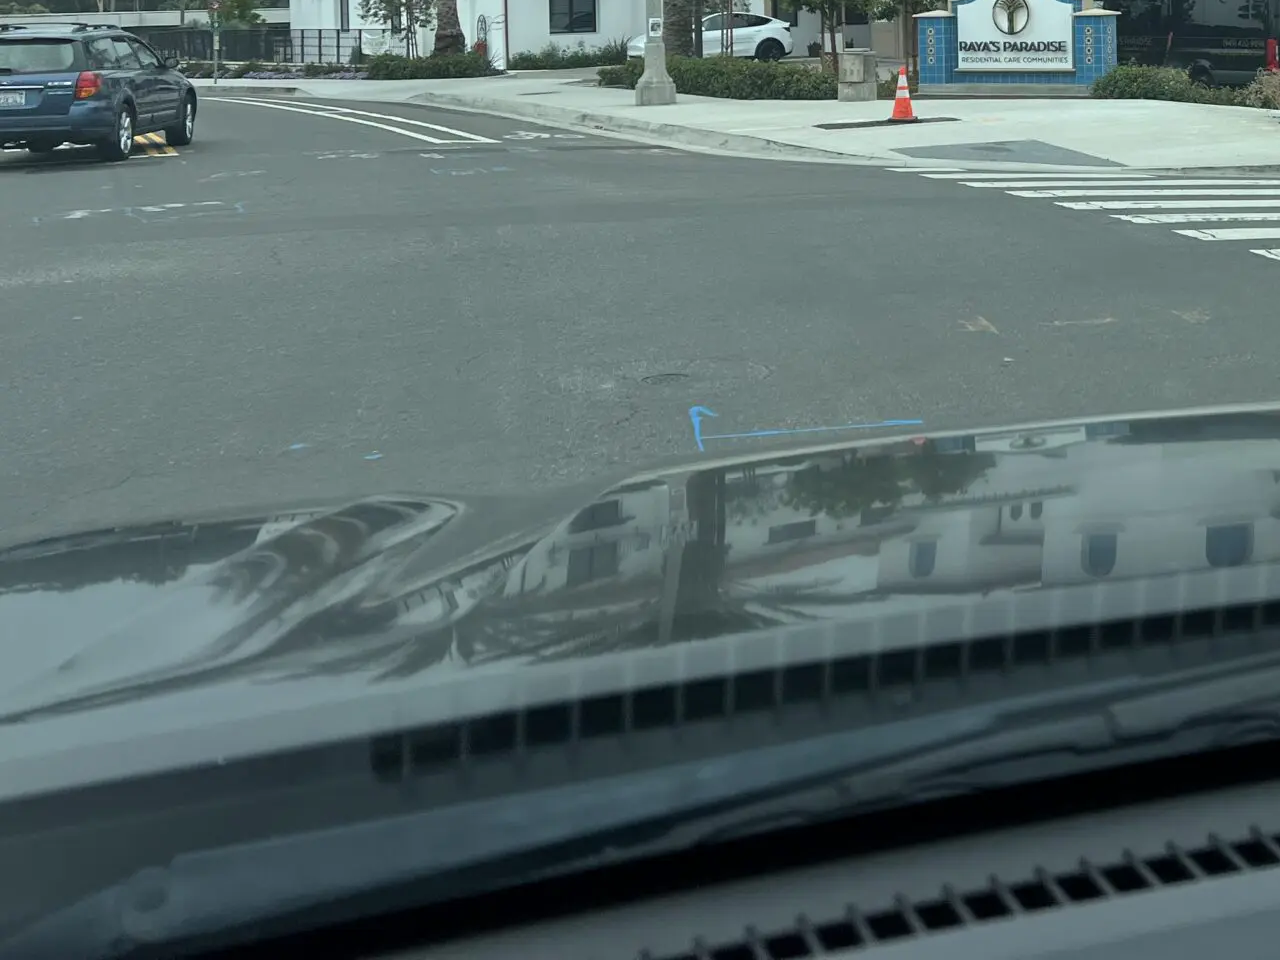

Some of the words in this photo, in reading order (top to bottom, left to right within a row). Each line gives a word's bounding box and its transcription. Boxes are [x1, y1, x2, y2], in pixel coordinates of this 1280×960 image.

[959, 41, 1001, 52] RAYA'S
[1003, 41, 1067, 52] PARADISE
[961, 56, 1002, 64] RESIDENTIAL
[1004, 56, 1021, 64] CARE
[1022, 56, 1069, 64] COMMUNITIES
